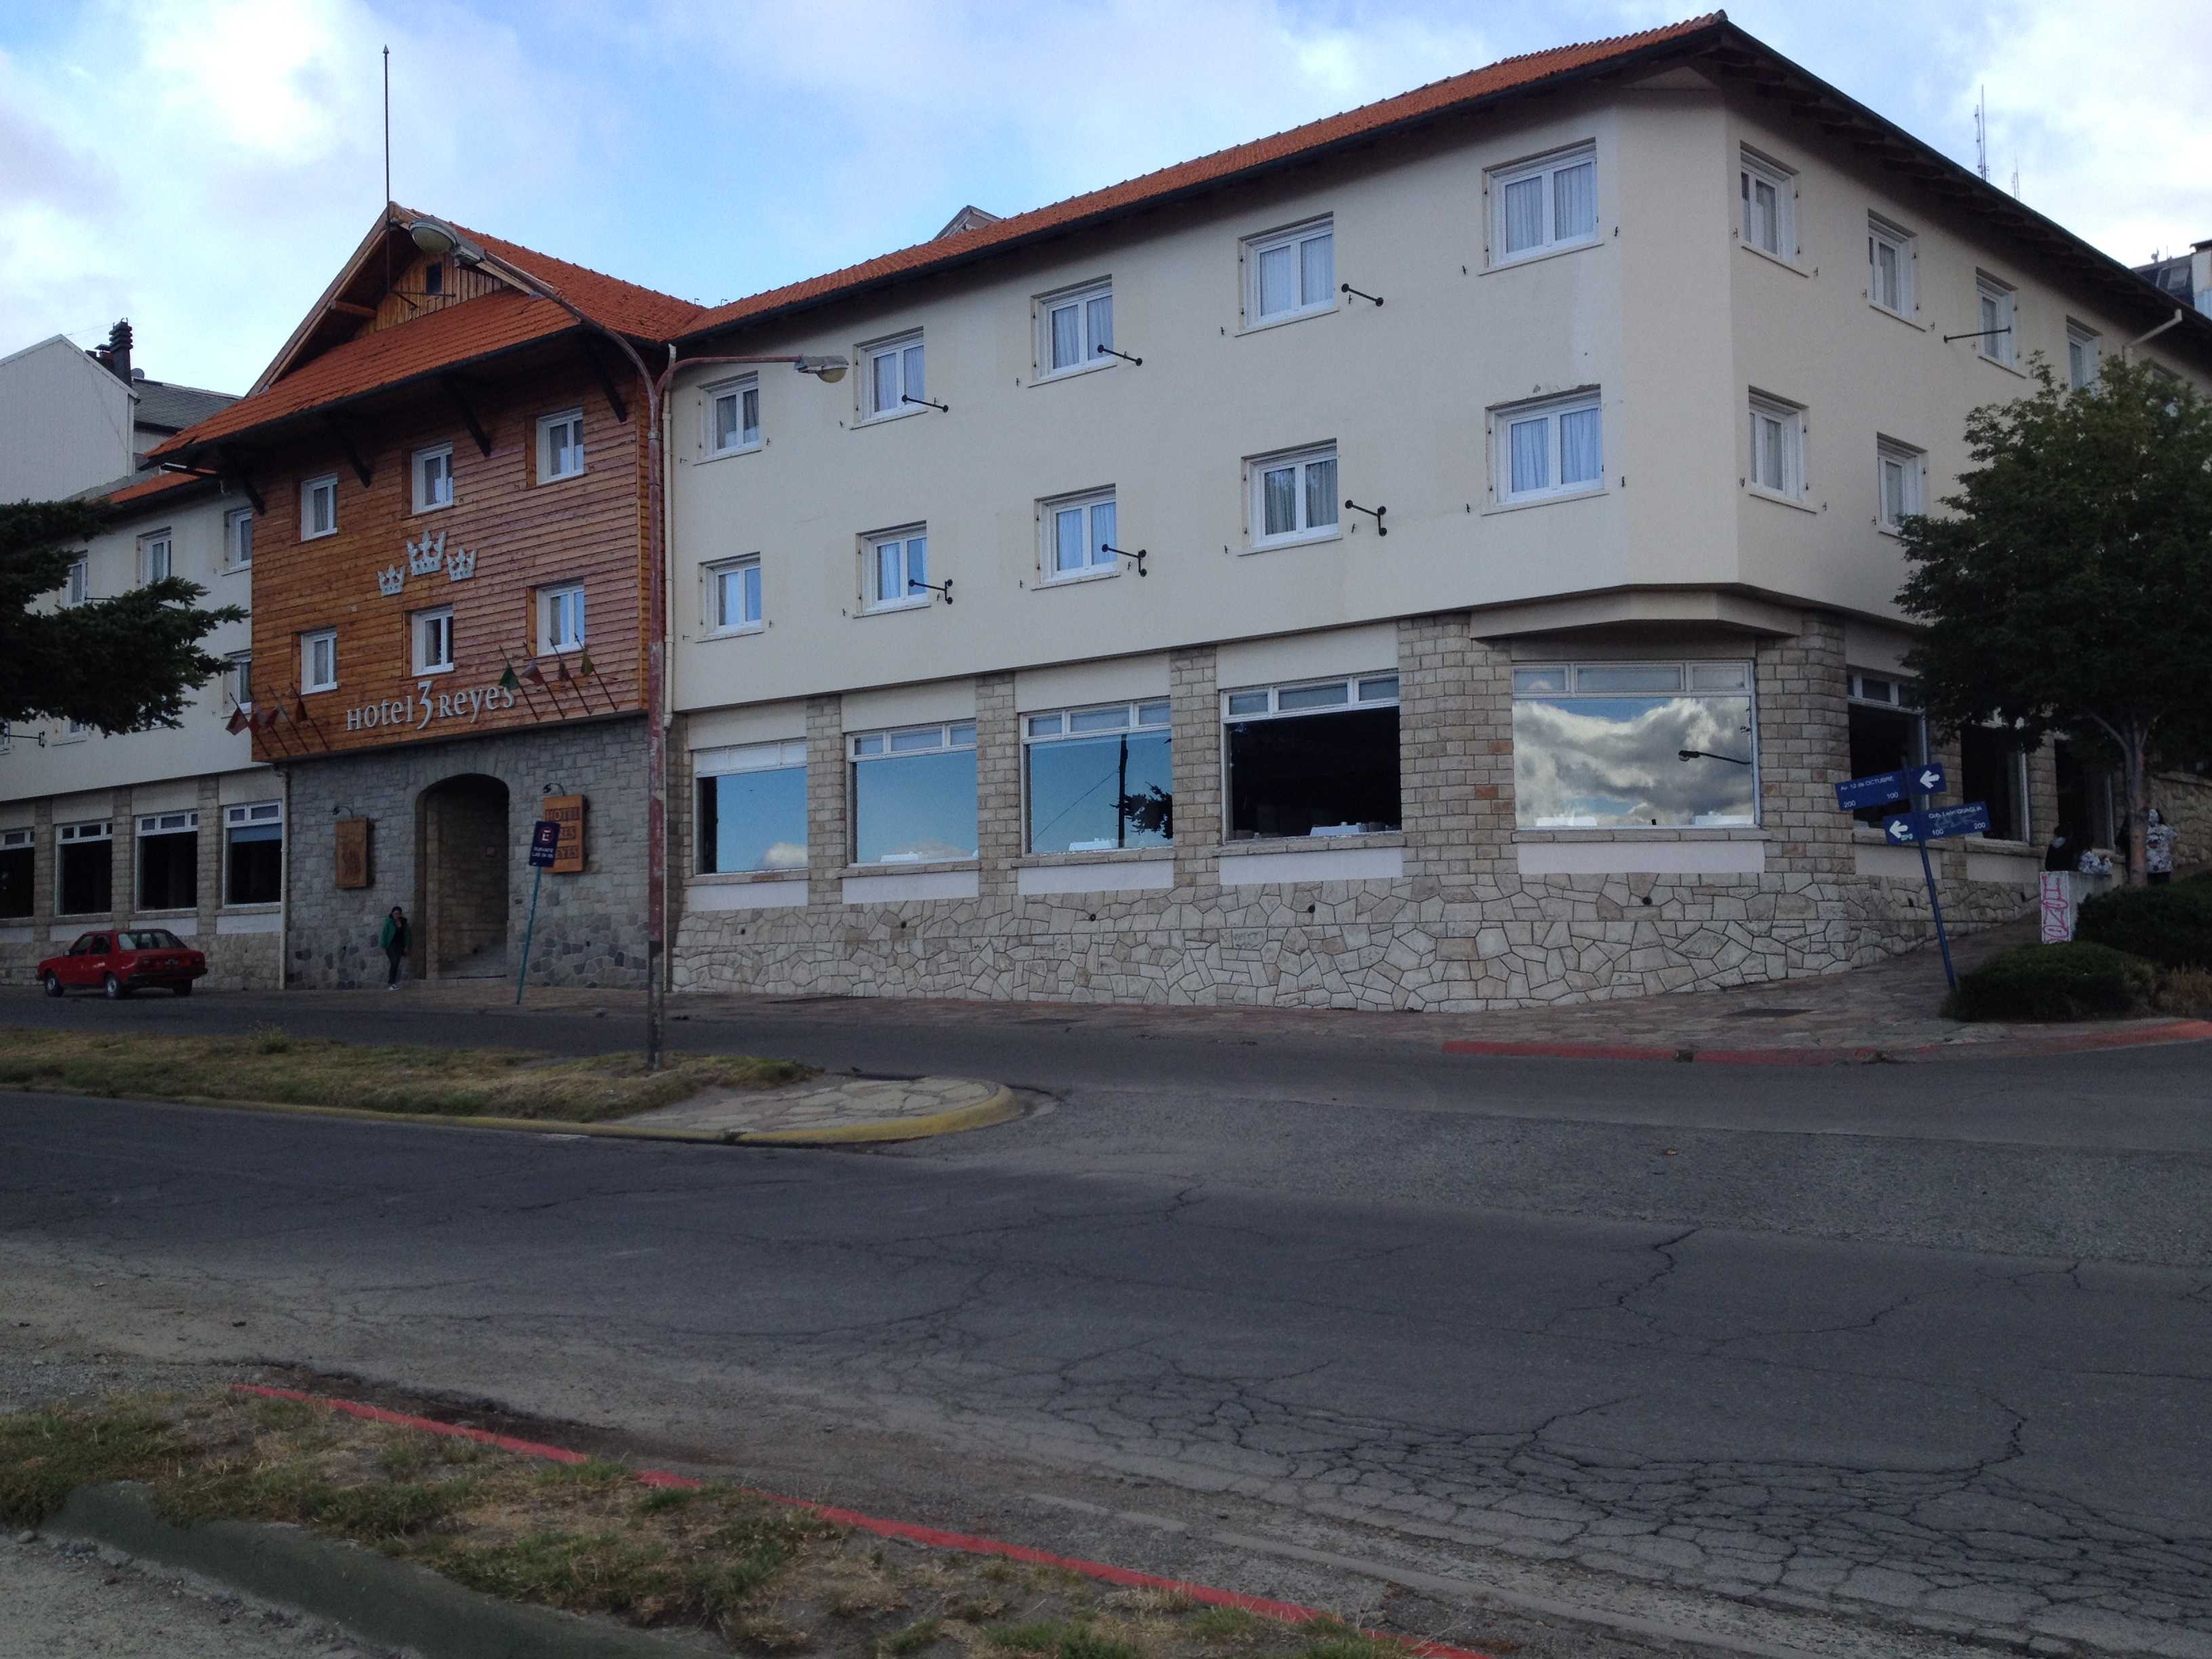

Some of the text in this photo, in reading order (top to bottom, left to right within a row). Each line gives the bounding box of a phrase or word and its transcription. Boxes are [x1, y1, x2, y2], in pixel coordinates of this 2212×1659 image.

[346, 680, 516, 731] Hotel 3 Reyes
[1865, 775, 1894, 786] OCTUBRE
[1886, 792, 1899, 800] 100
[1843, 800, 1856, 808] 200
[1973, 821, 1986, 830] 200
[1931, 828, 1944, 836] 100
